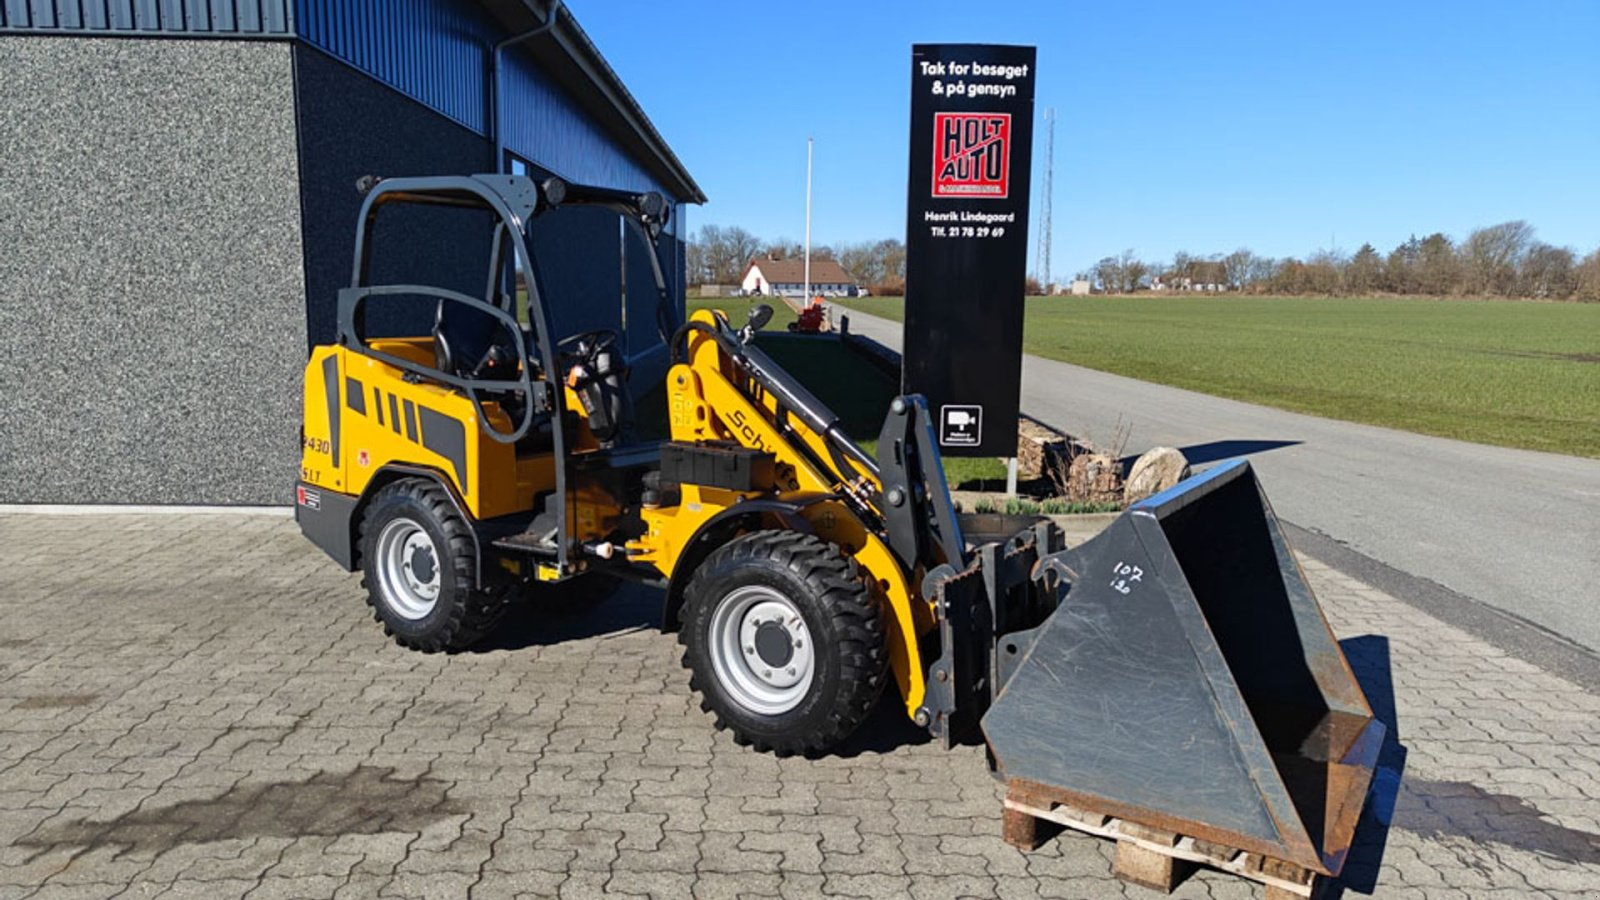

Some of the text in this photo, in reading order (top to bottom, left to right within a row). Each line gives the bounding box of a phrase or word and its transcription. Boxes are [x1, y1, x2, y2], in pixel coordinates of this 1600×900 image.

[920, 61, 1028, 79] Tak for besøget
[931, 80, 1017, 98] & på gensyn
[943, 117, 1004, 161] HOLT
[939, 138, 1004, 181] AUTO
[924, 210, 1015, 224] Henrik Lindegaard
[948, 226, 960, 237] 21
[961, 226, 975, 237] 78
[976, 226, 990, 237] 29
[991, 227, 1005, 238] 69
[725, 410, 771, 452] Sch
